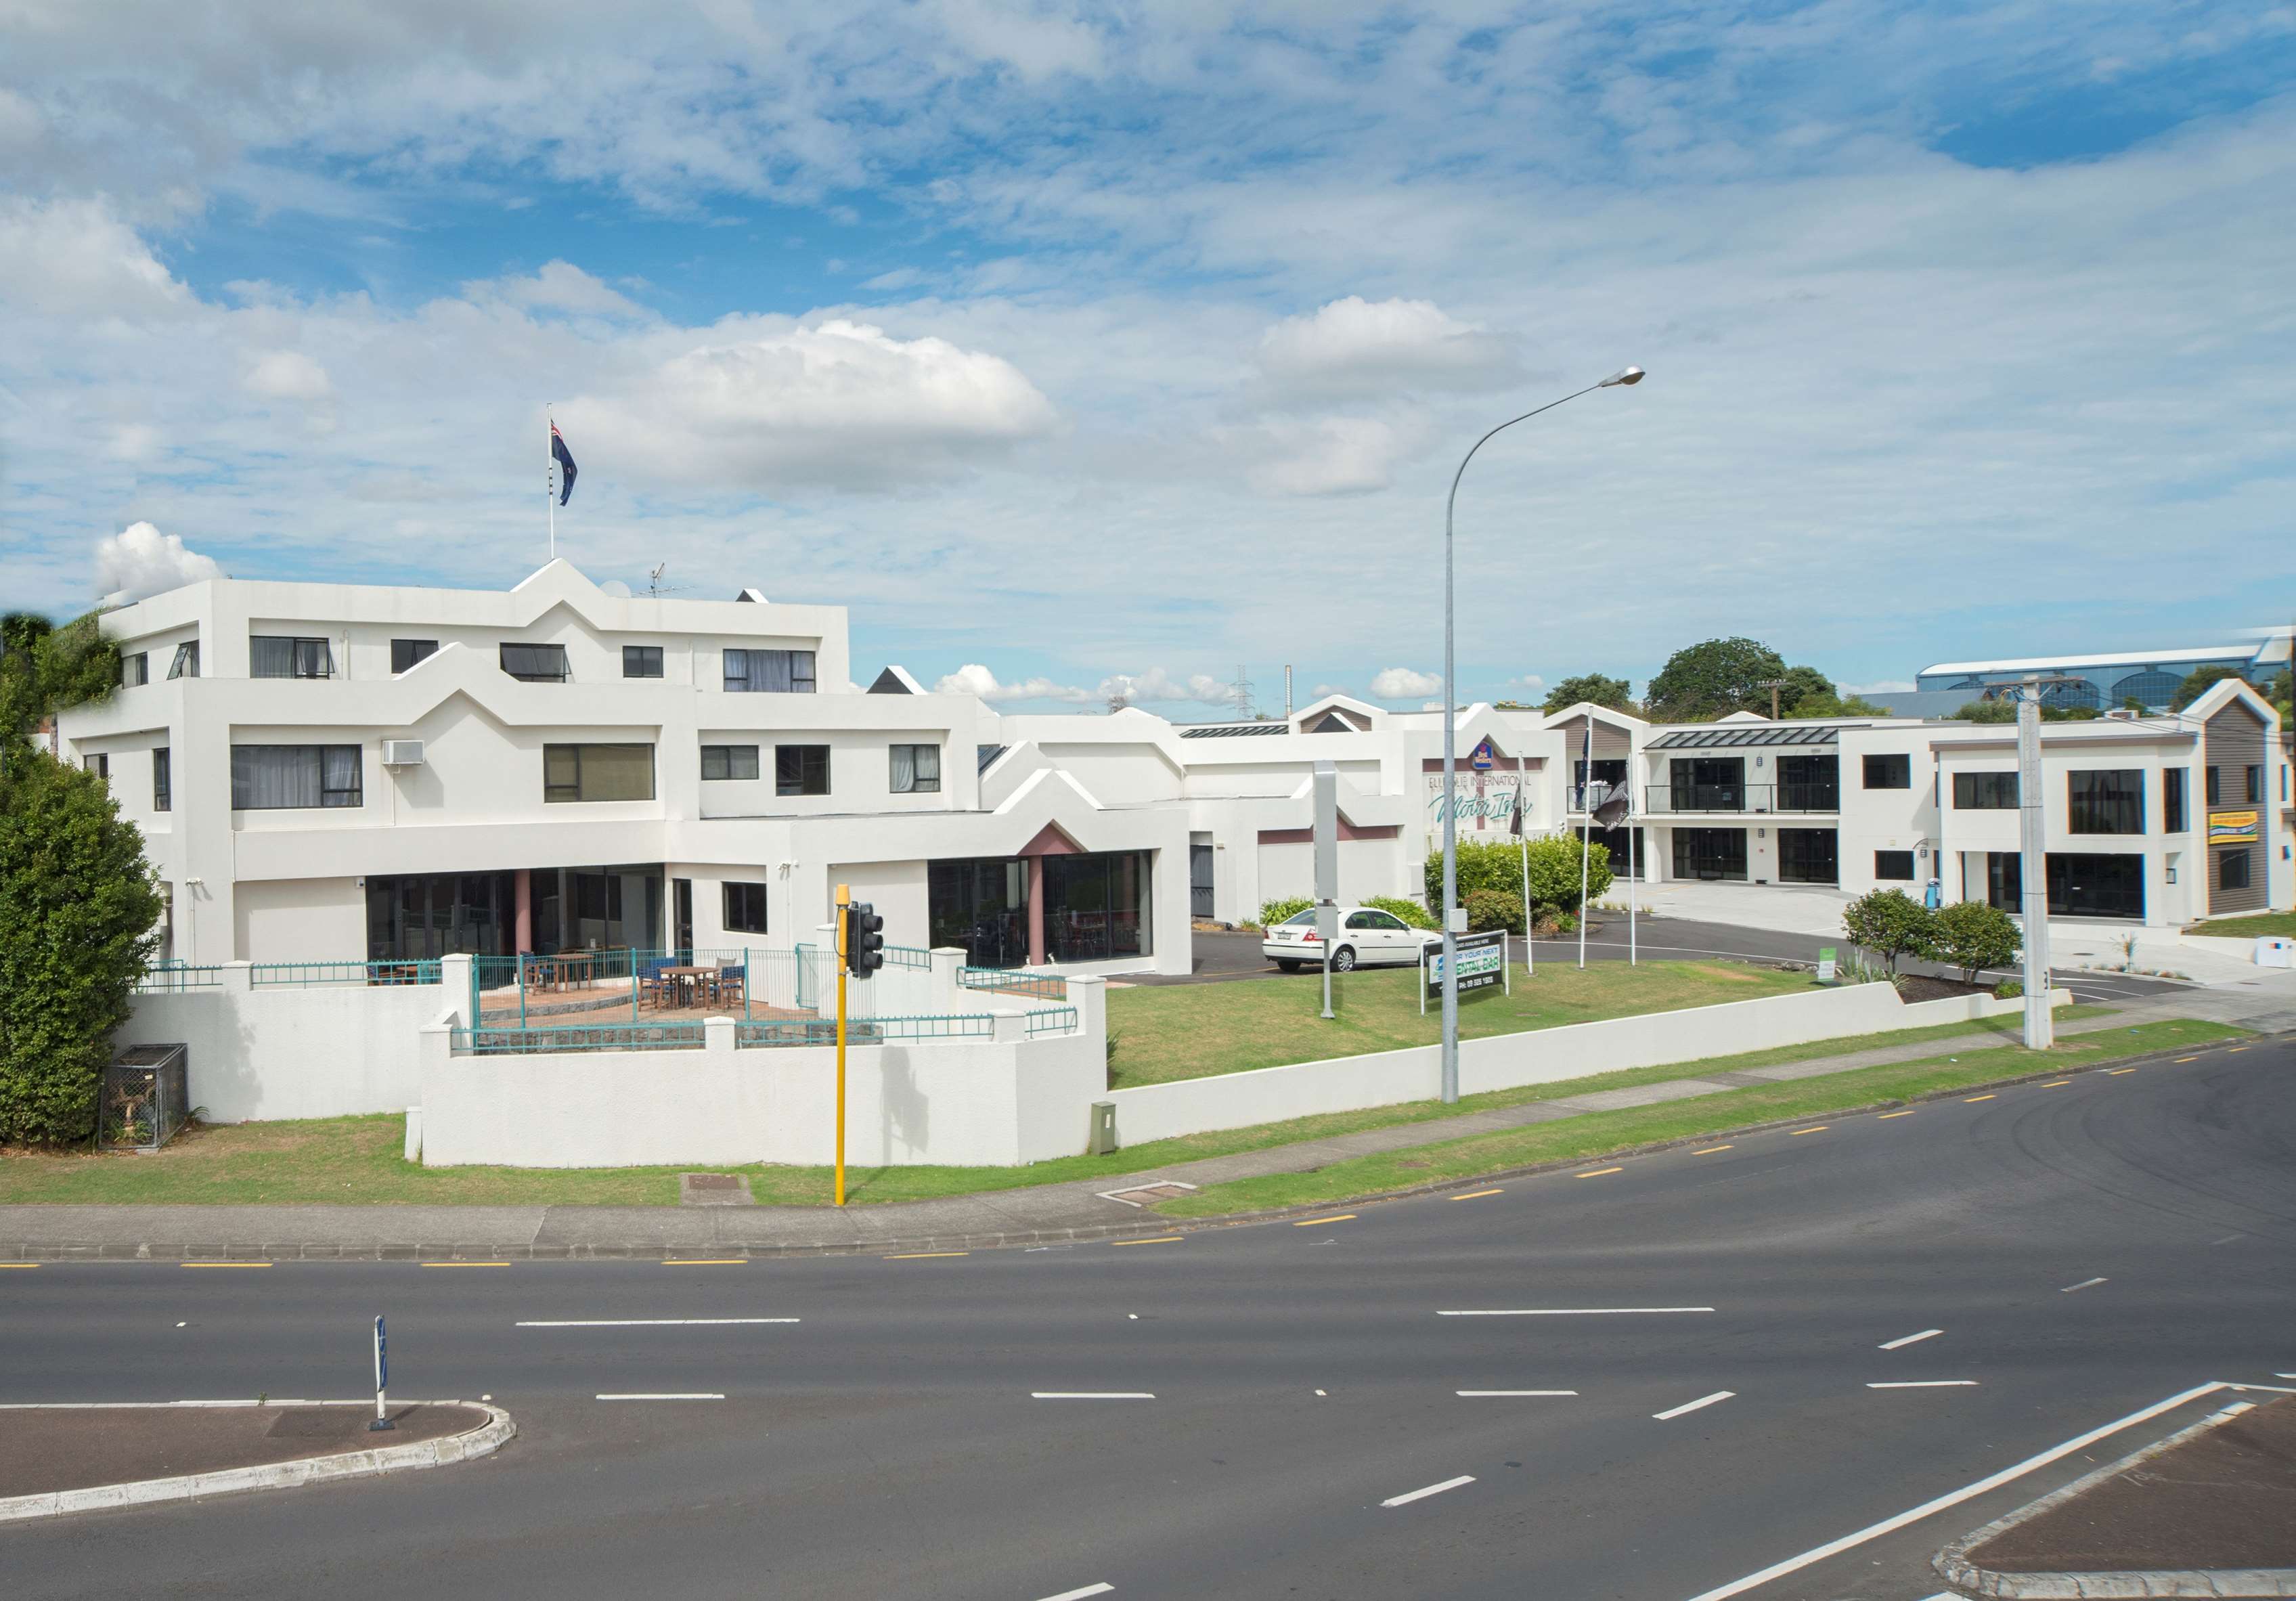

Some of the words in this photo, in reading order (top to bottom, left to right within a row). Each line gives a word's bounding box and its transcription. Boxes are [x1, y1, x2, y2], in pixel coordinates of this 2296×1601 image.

[1470, 775, 1532, 787] INTERNATIONL
[1464, 950, 1481, 959] YOUR
[1482, 946, 1498, 955] NEXT
[1456, 960, 1480, 975] ENTAL
